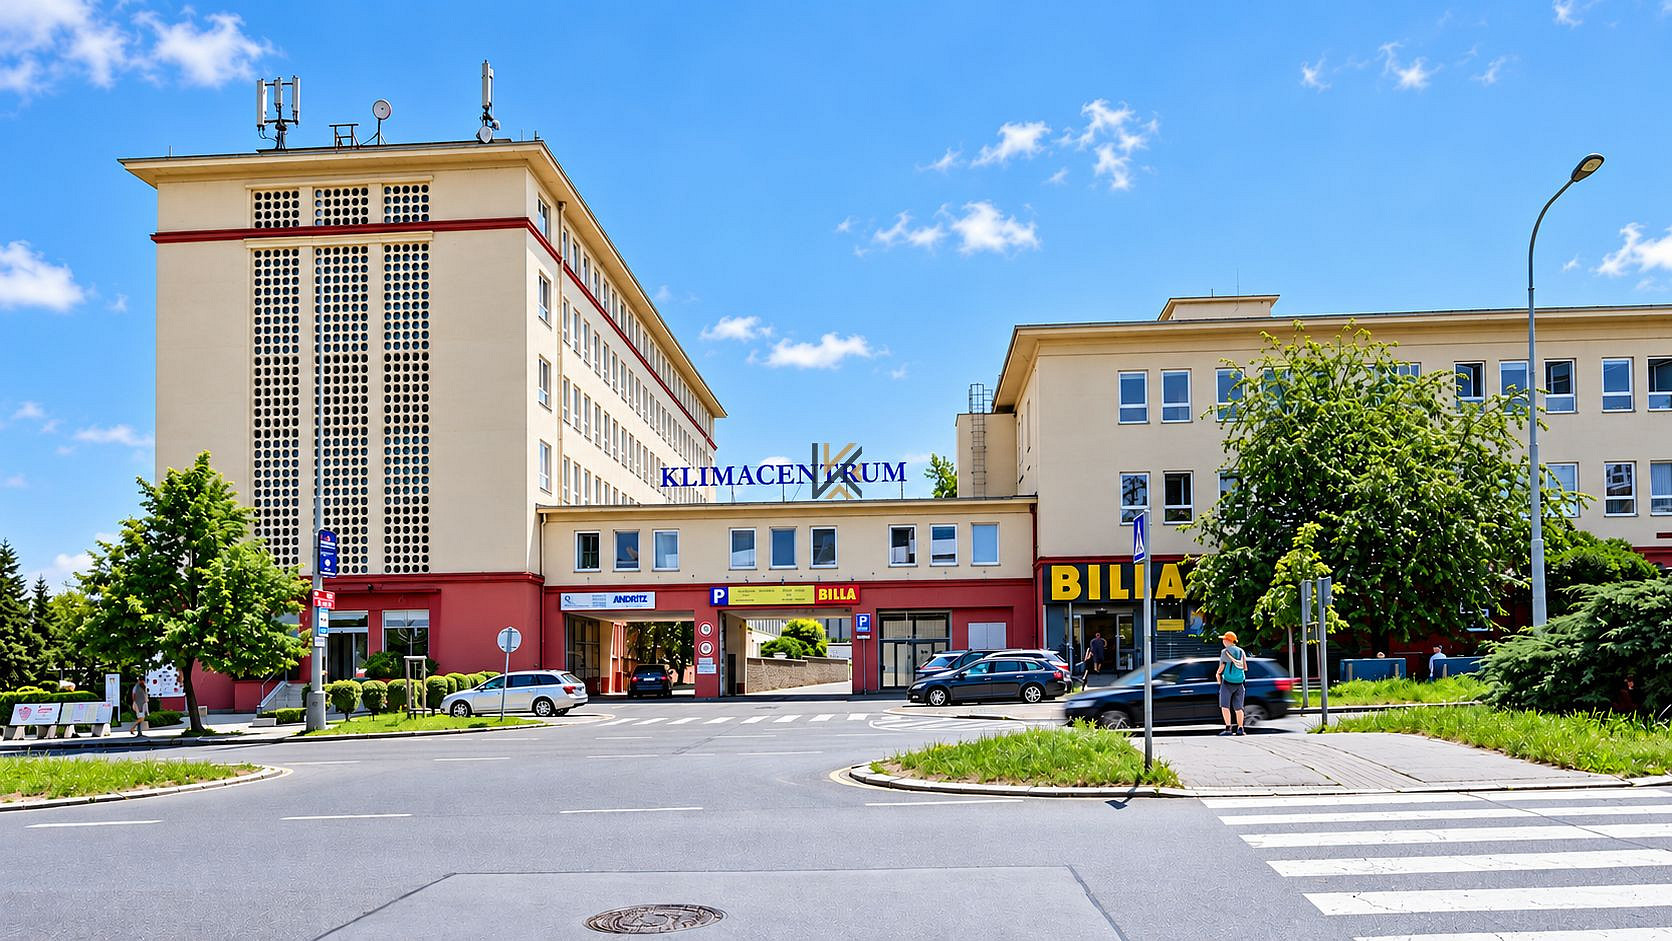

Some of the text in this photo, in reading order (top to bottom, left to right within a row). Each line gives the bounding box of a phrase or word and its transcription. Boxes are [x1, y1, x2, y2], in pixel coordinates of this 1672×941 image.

[660, 462, 907, 487] KLIMACENTRUM
[1051, 563, 1186, 600] BILLA
[613, 595, 648, 603] ANDRITZ
[713, 589, 725, 604] P
[818, 588, 856, 600] BILLA
[859, 615, 867, 626] P
